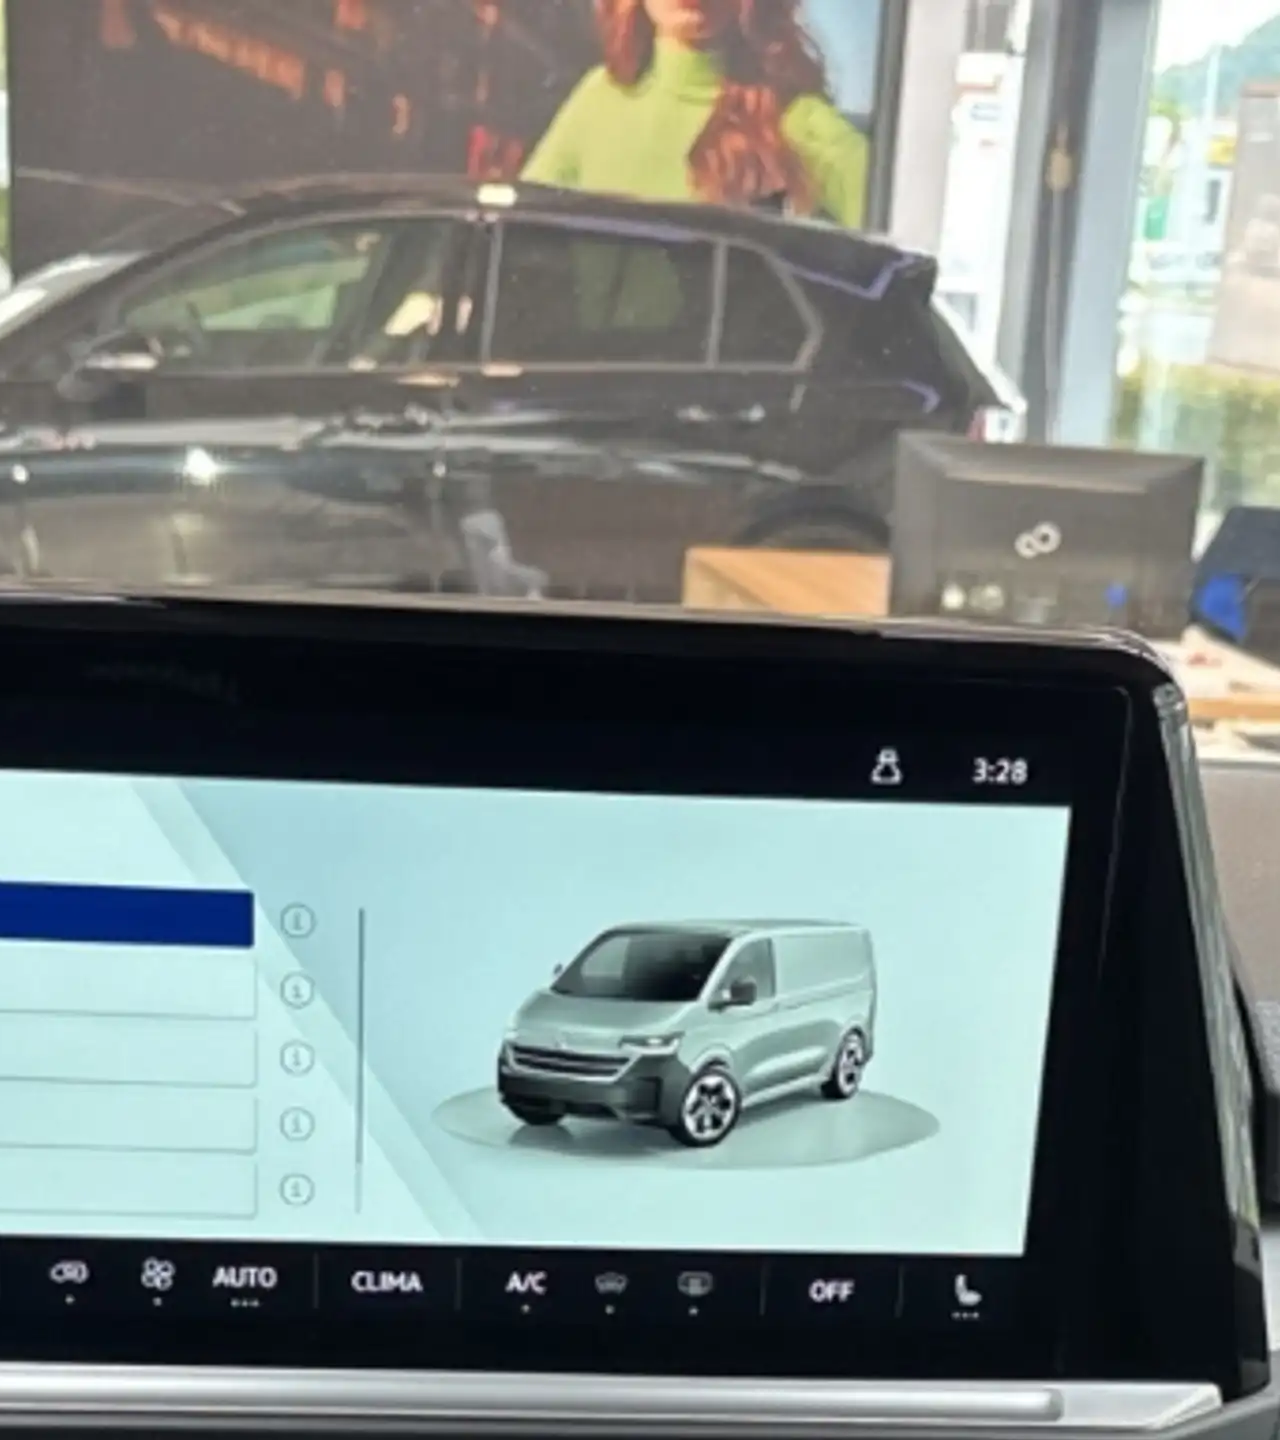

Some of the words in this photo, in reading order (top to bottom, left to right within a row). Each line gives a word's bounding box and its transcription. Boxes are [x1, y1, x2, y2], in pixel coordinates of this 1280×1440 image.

[973, 757, 1028, 784] 3:28
[212, 1266, 278, 1288] AUTO
[351, 1270, 423, 1292] CLIMA
[505, 1271, 546, 1294] A/C
[809, 1279, 854, 1302] OFF
